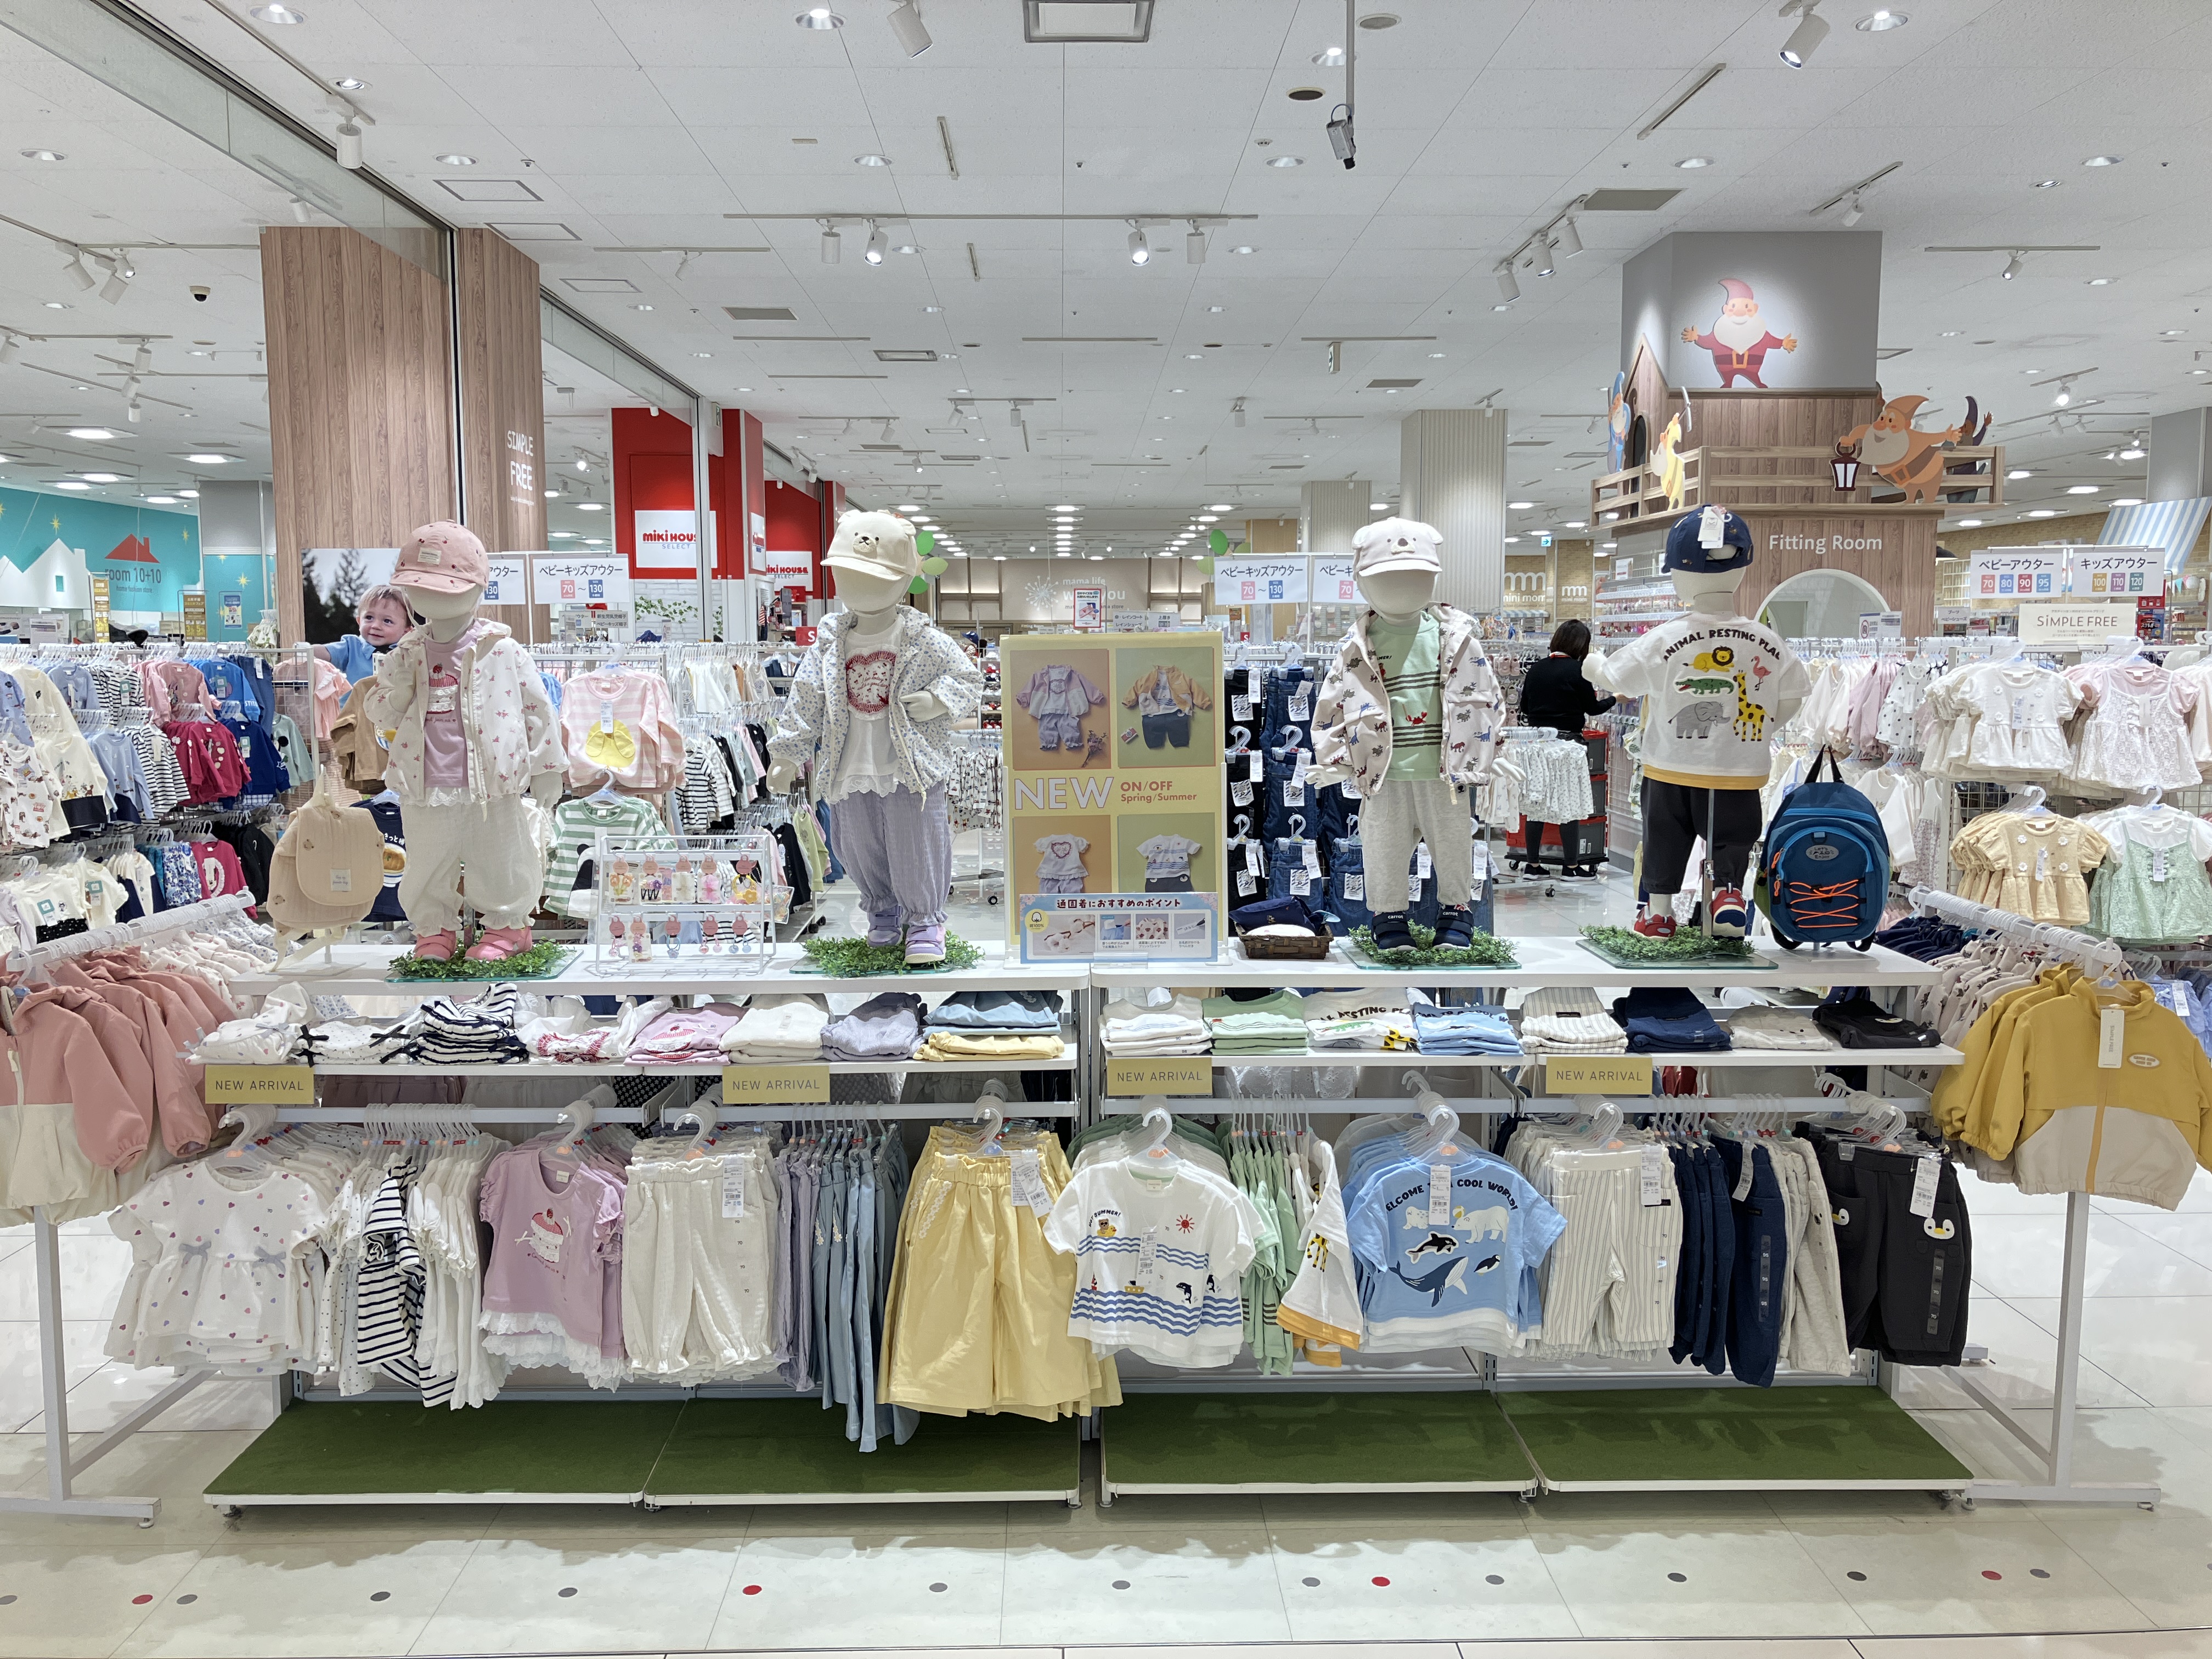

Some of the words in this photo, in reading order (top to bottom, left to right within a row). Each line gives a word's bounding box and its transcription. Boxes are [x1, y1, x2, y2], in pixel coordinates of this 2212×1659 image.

[507, 430, 534, 456] SIMPLE
[511, 461, 533, 490] FREE
[643, 529, 668, 542] miki
[1769, 534, 1826, 554] Fitting
[1832, 535, 1882, 550] Room
[1979, 558, 2054, 570] ベビーアウター
[2081, 557, 2157, 569] キッズアウター
[539, 564, 623, 576] ベビーキッズアウター
[766, 565, 779, 574] iki
[1221, 565, 1303, 577] ベビーキッズアウター
[1320, 565, 1353, 577] ベビーキ
[105, 568, 131, 582] room
[134, 567, 161, 584] 10+10
[1092, 577, 1105, 585] life
[2001, 579, 2012, 588] 80
[2019, 579, 2031, 587] 90
[2038, 578, 2049, 587] 95
[2094, 578, 2106, 586] 100
[2112, 578, 2124, 586] 110
[2131, 577, 2142, 586] 120
[562, 584, 574, 593] 70
[590, 584, 602, 593] 130
[1243, 586, 1254, 595] 70
[1269, 585, 1283, 594] 130
[1340, 585, 1352, 594] 70
[2087, 616, 2118, 627] FREE
[1709, 628, 1756, 642] RESTING
[1120, 781, 1173, 792] ON/OFF
[1014, 777, 1114, 810] NEW
[1057, 898, 1181, 909] 通園着におすすめのポイント
[1118, 1072, 1144, 1082] NEW
[1150, 1071, 1203, 1081] ARRIVAL
[1556, 1071, 1583, 1081] NEW
[1590, 1071, 1643, 1081] ARRIVAL
[216, 1080, 244, 1090] NEW
[250, 1080, 303, 1091] ARRIVAL
[732, 1080, 760, 1090] NEW
[767, 1080, 820, 1090] ARRIVAL
[1385, 1184, 1424, 1212] ELCOME
[1457, 1179, 1483, 1188] COOL
[1488, 1181, 1518, 1210] WORLD!
[1094, 1209, 1121, 1217] SUMMER!
